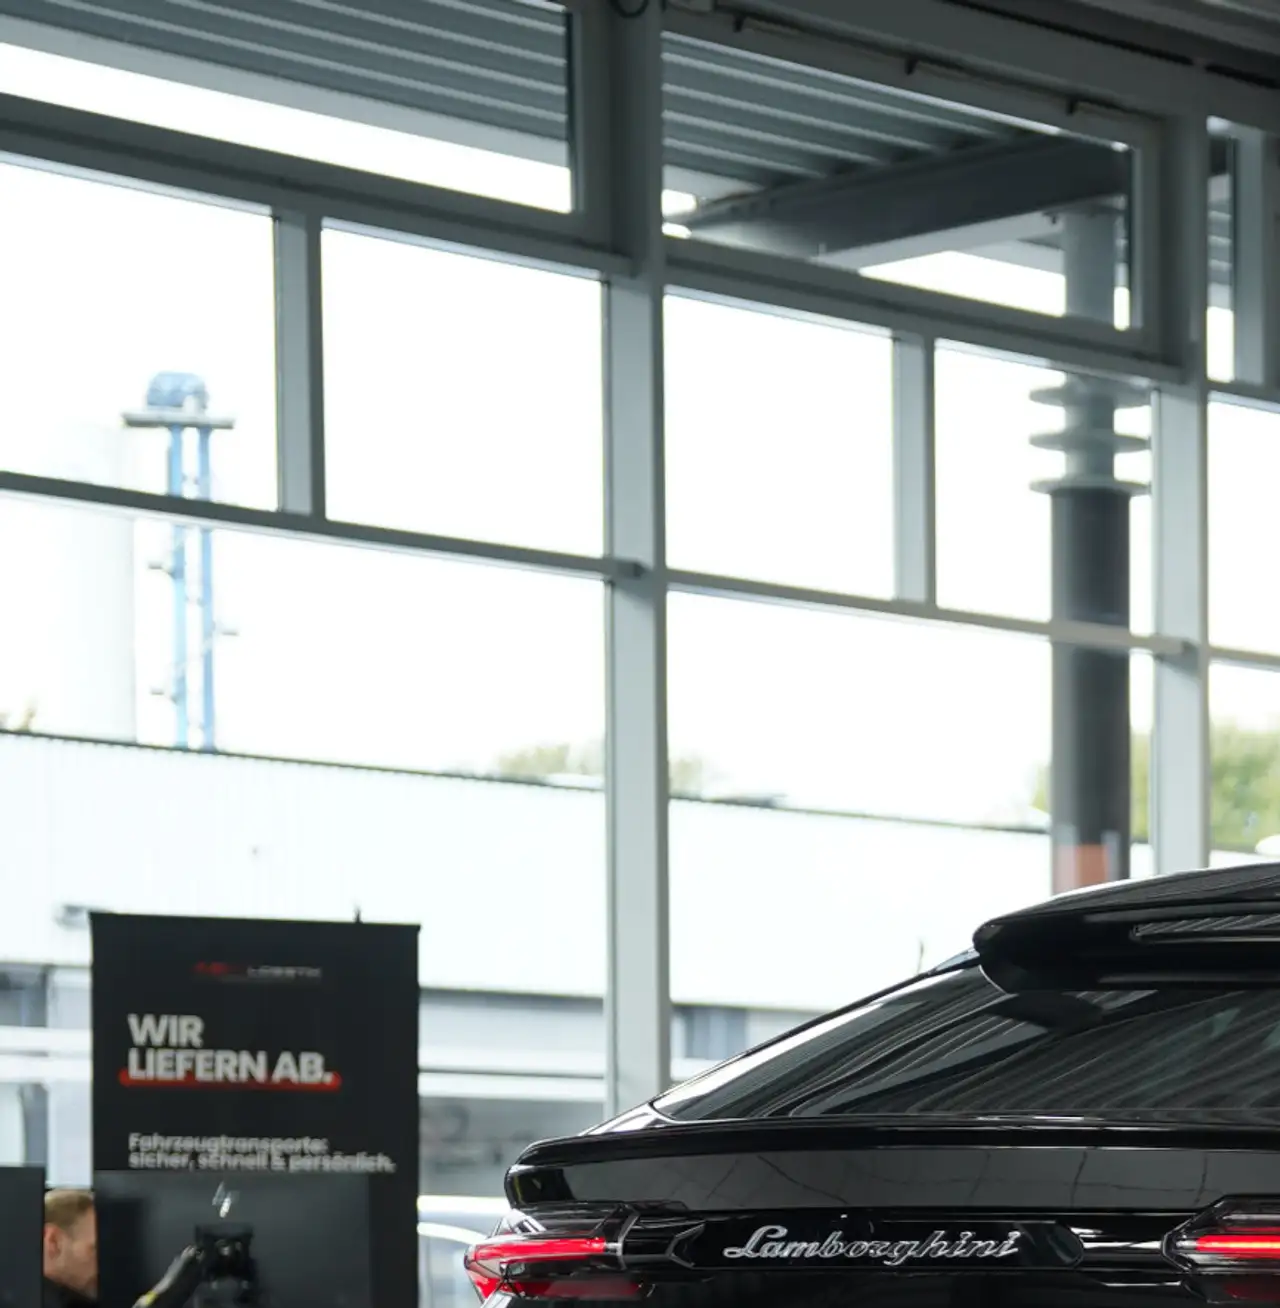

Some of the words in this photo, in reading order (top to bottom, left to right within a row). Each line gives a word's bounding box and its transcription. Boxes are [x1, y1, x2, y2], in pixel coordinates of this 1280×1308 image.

[128, 1013, 204, 1048] WIR
[128, 1048, 268, 1083] LIEFERN
[272, 1051, 334, 1085] AB.
[198, 1151, 268, 1170] schnell
[722, 1224, 1021, 1266] Lamborghini
